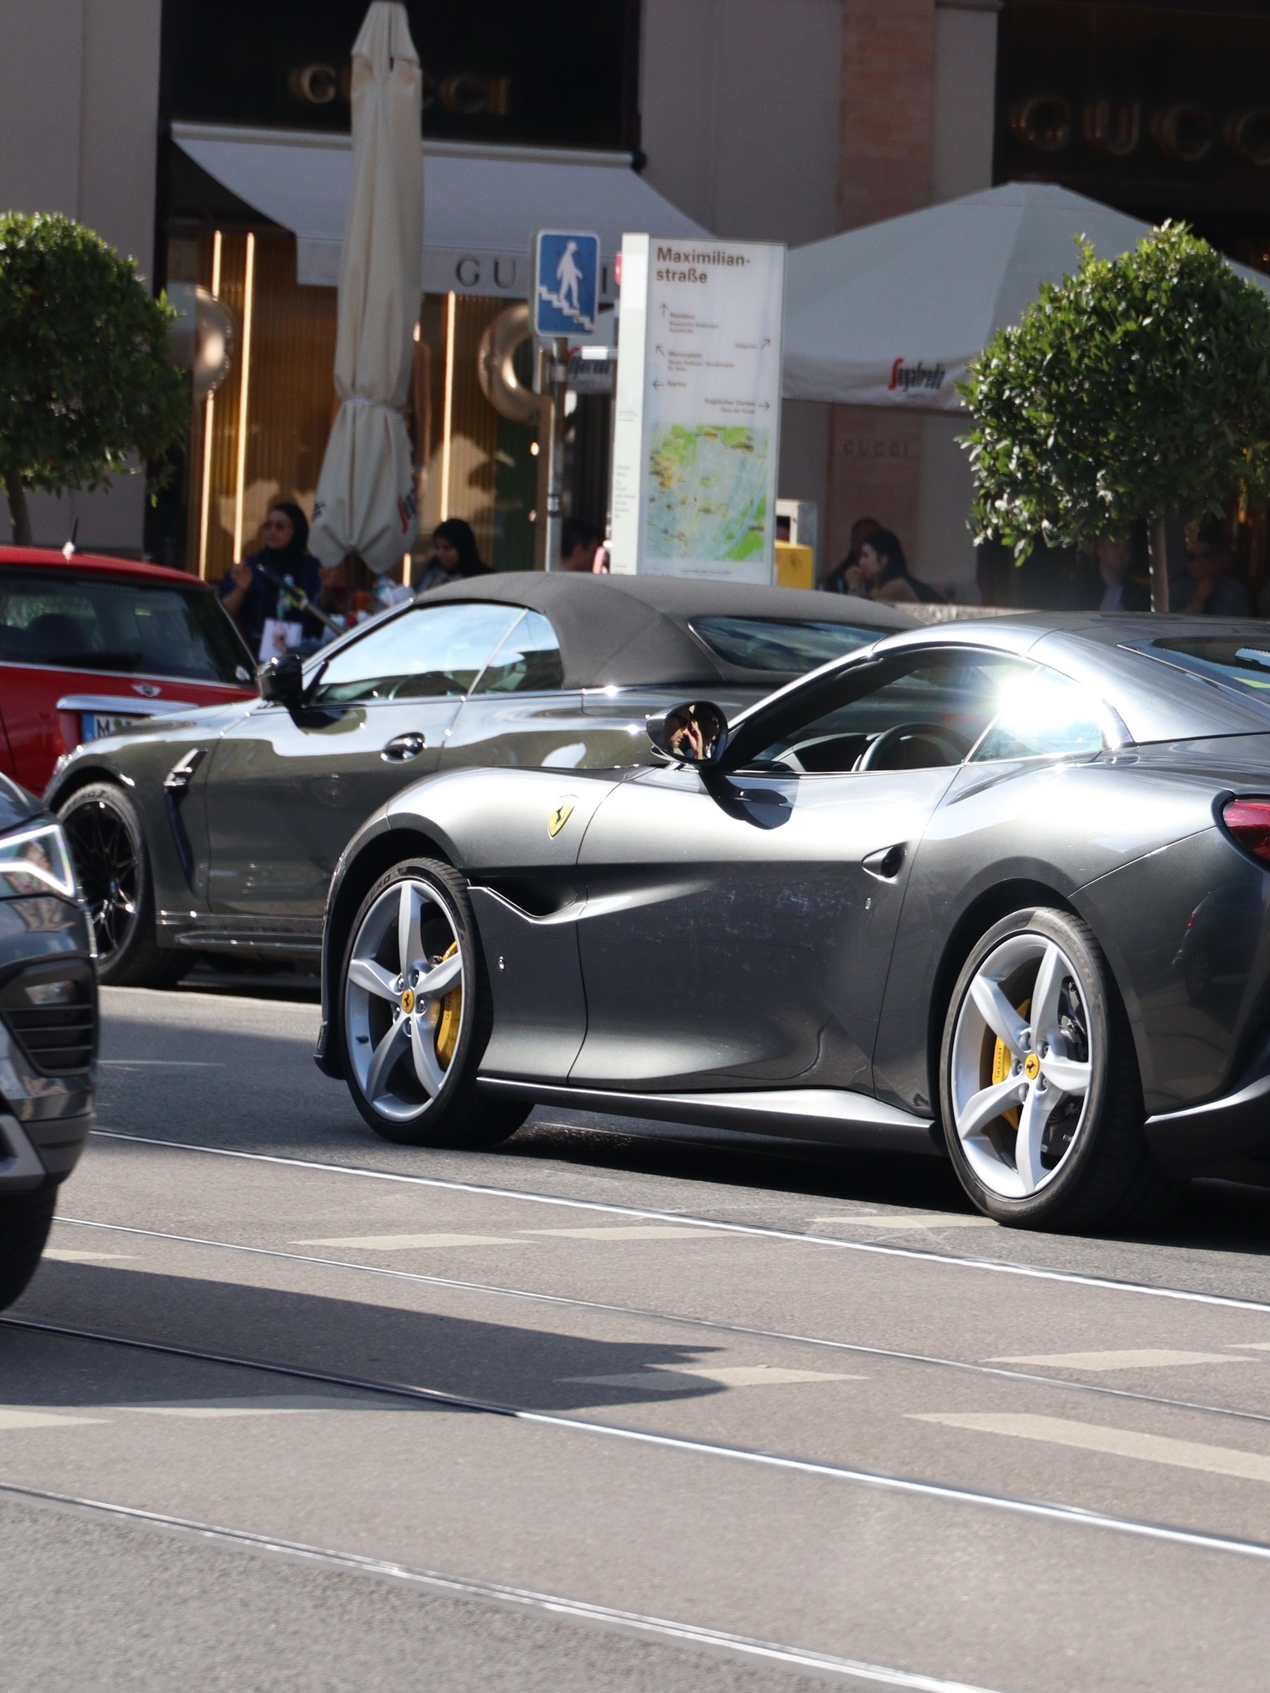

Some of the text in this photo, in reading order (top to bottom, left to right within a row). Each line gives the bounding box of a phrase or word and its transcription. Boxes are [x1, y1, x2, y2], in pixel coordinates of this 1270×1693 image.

[656, 247, 751, 267] Maximilian-
[455, 254, 608, 295] GUI
[656, 268, 708, 284] straße
